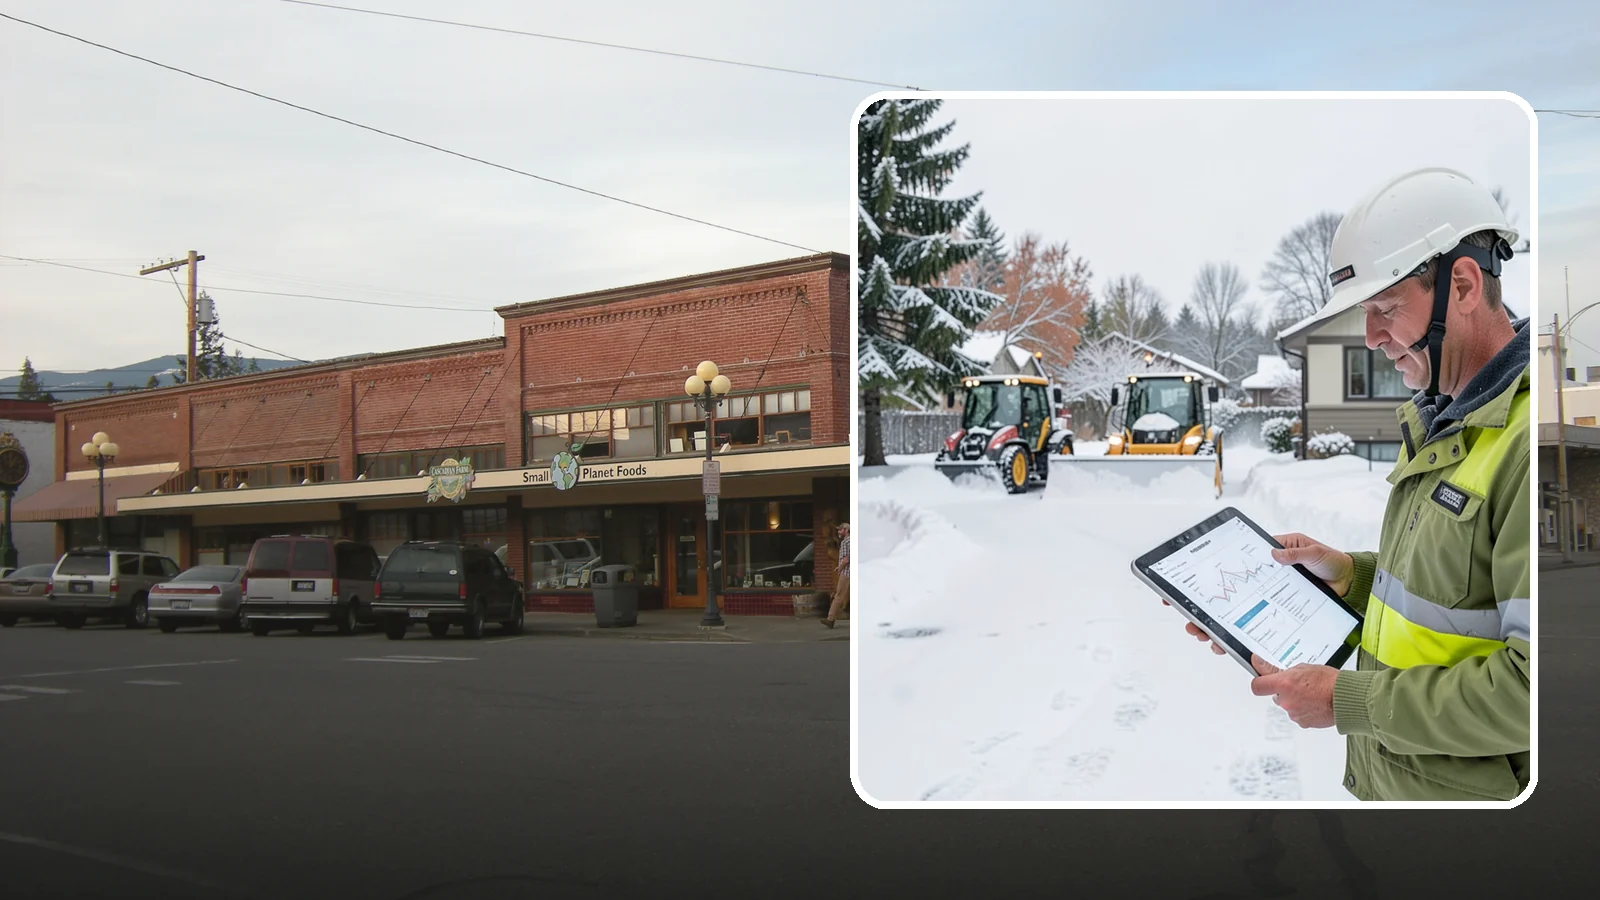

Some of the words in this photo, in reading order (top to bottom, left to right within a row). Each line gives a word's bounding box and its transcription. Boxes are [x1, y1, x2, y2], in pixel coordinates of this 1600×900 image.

[523, 471, 549, 483] Small
[583, 467, 614, 479] Planet
[617, 464, 647, 477] Foods
